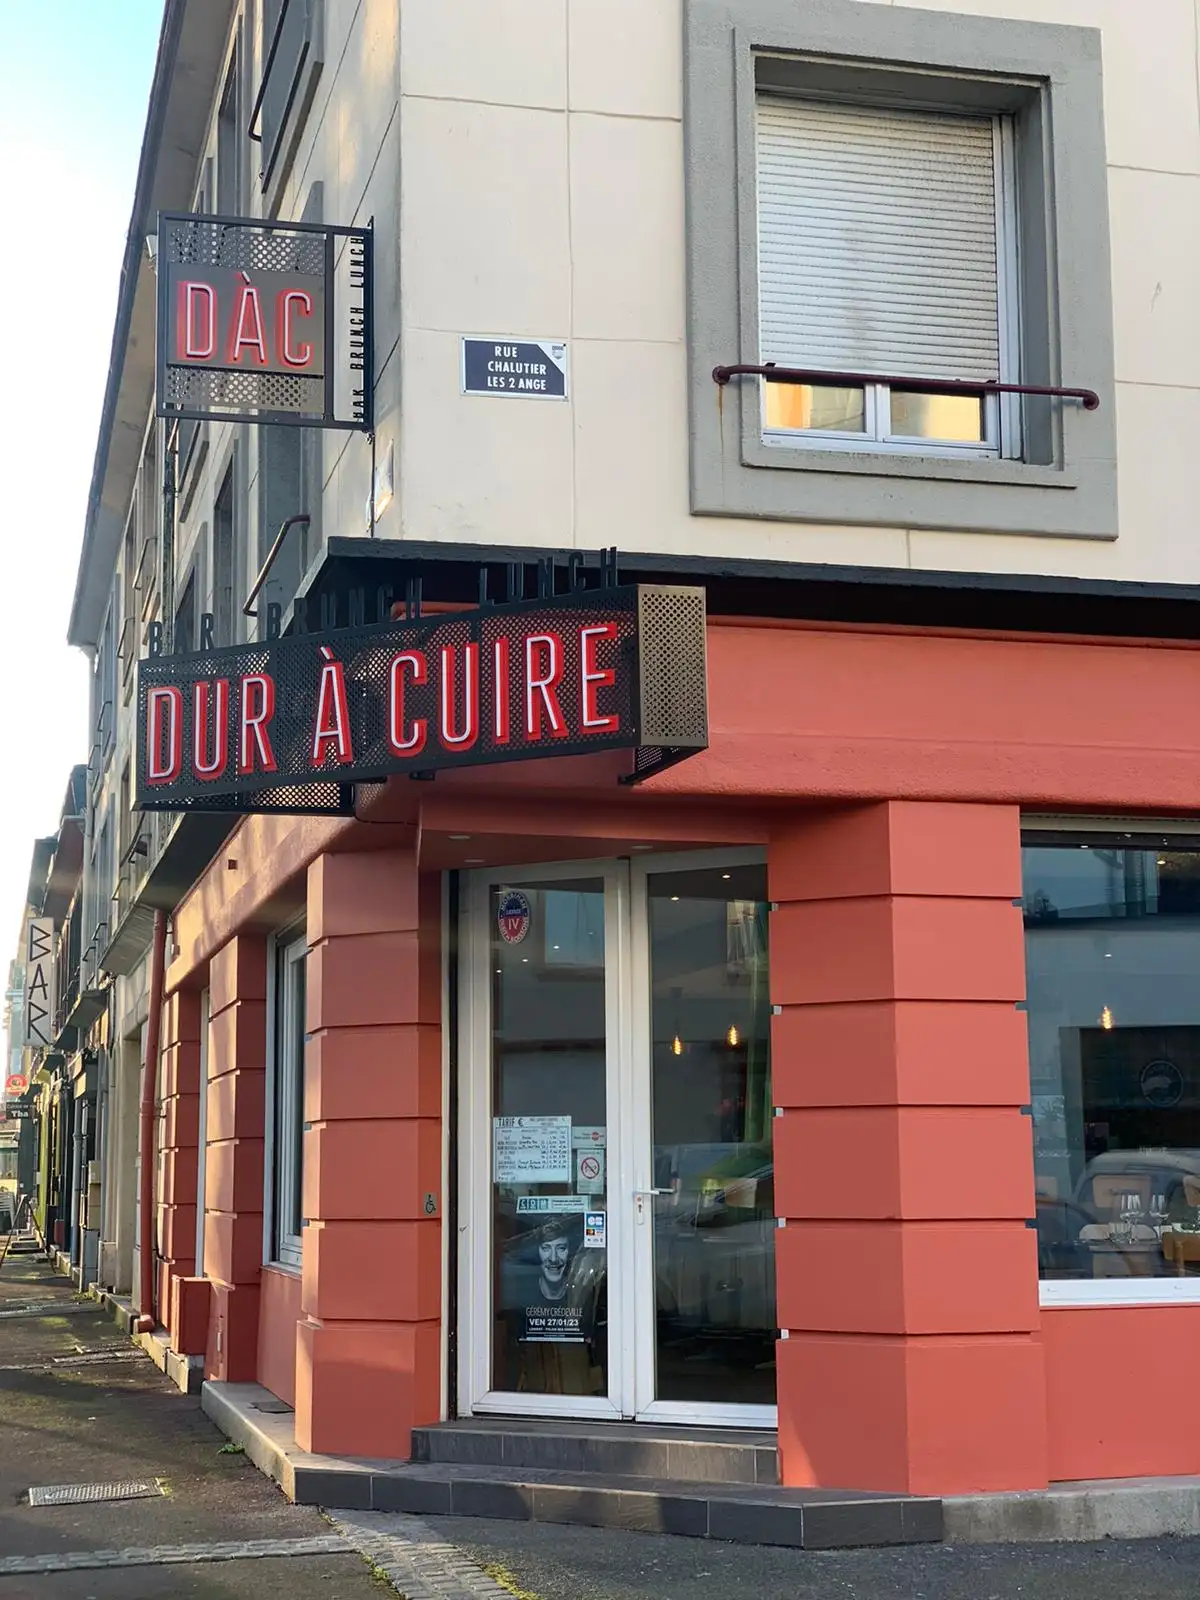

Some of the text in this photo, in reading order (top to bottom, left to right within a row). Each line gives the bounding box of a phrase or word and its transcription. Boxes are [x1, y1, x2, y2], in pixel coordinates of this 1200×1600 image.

[350, 236, 364, 288] LUNCH
[177, 270, 315, 368] DÀC
[350, 307, 364, 370] BRUNCH
[487, 360, 547, 376] CHALUTIER
[494, 345, 518, 358] RUE
[487, 376, 547, 390] LES 2 ANGE
[267, 575, 423, 639] BRUNCH
[479, 547, 618, 607] LUNCH
[147, 622, 620, 785] DUR À CUIRE
[508, 918, 520, 930] IV
[28, 923, 53, 1045] BAR
[529, 1318, 579, 1327] VEN 27/01/23
